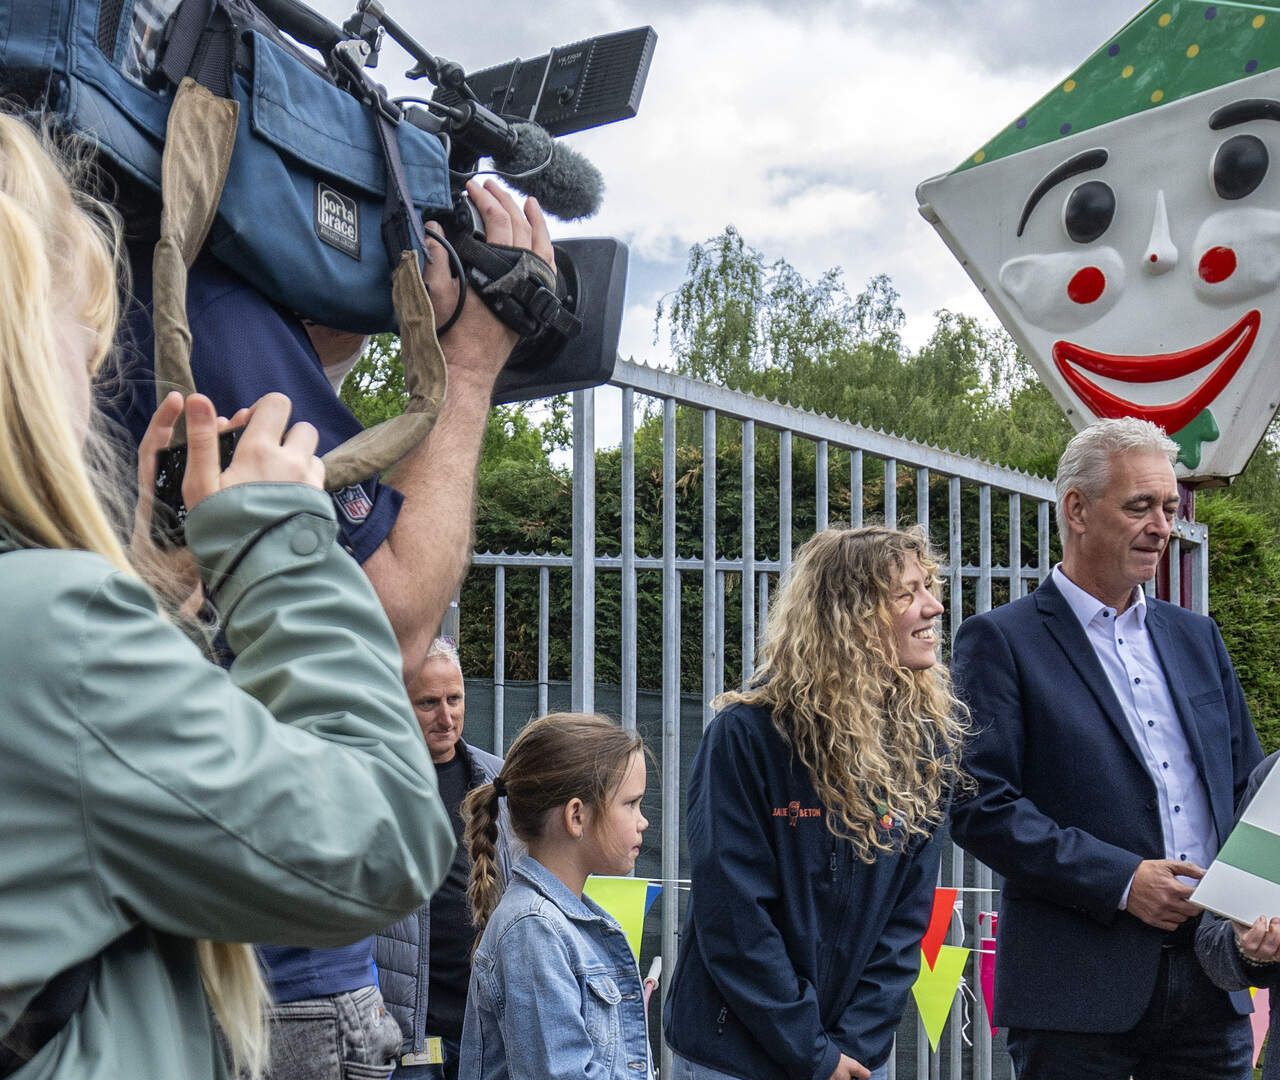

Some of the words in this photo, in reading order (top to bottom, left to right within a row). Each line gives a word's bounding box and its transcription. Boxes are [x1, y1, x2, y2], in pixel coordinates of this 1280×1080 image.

[321, 196, 355, 224] porta
[321, 210, 355, 239] brace
[800, 808, 821, 818] BETON
